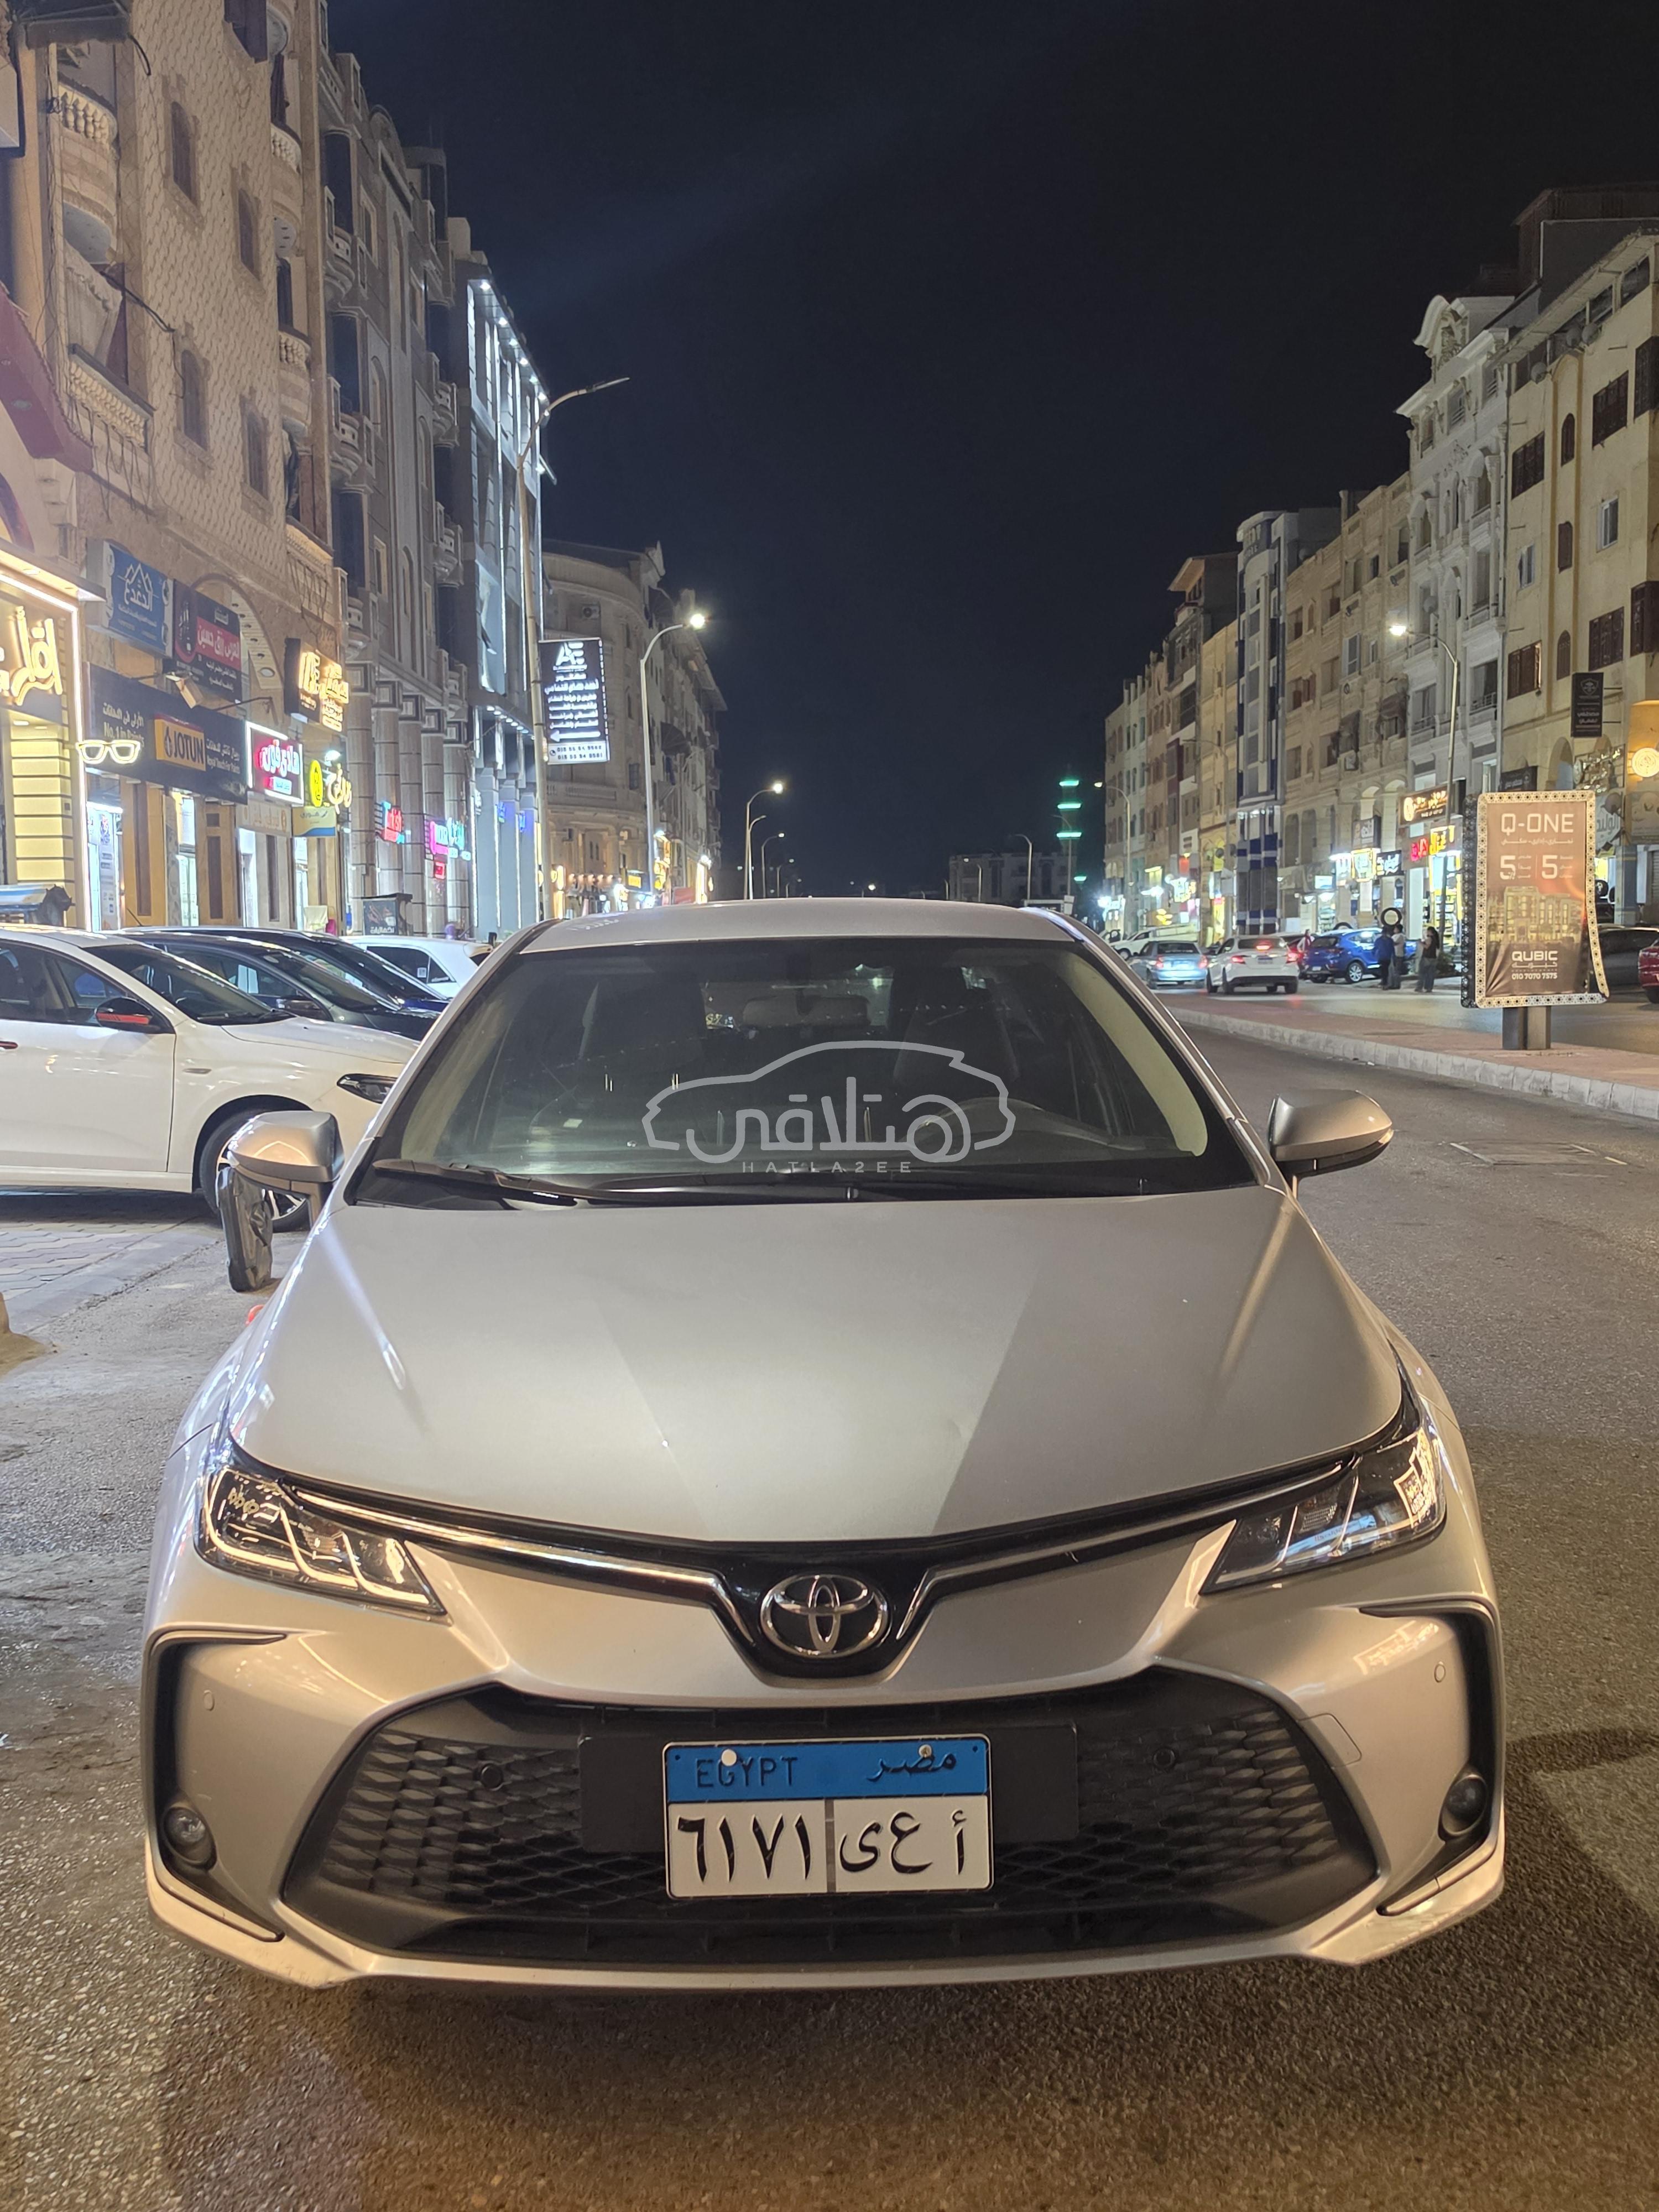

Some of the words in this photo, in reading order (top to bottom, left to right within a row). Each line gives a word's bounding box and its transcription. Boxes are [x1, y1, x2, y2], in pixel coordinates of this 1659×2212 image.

[174, 731, 204, 765] JOTUN
[1501, 813, 1574, 836] Q-ONE
[1541, 855, 1558, 879] 5
[1512, 951, 1558, 962] QUBIC
[696, 1756, 799, 1788] EGYPT
[677, 1815, 811, 1882] ٦١٧١
